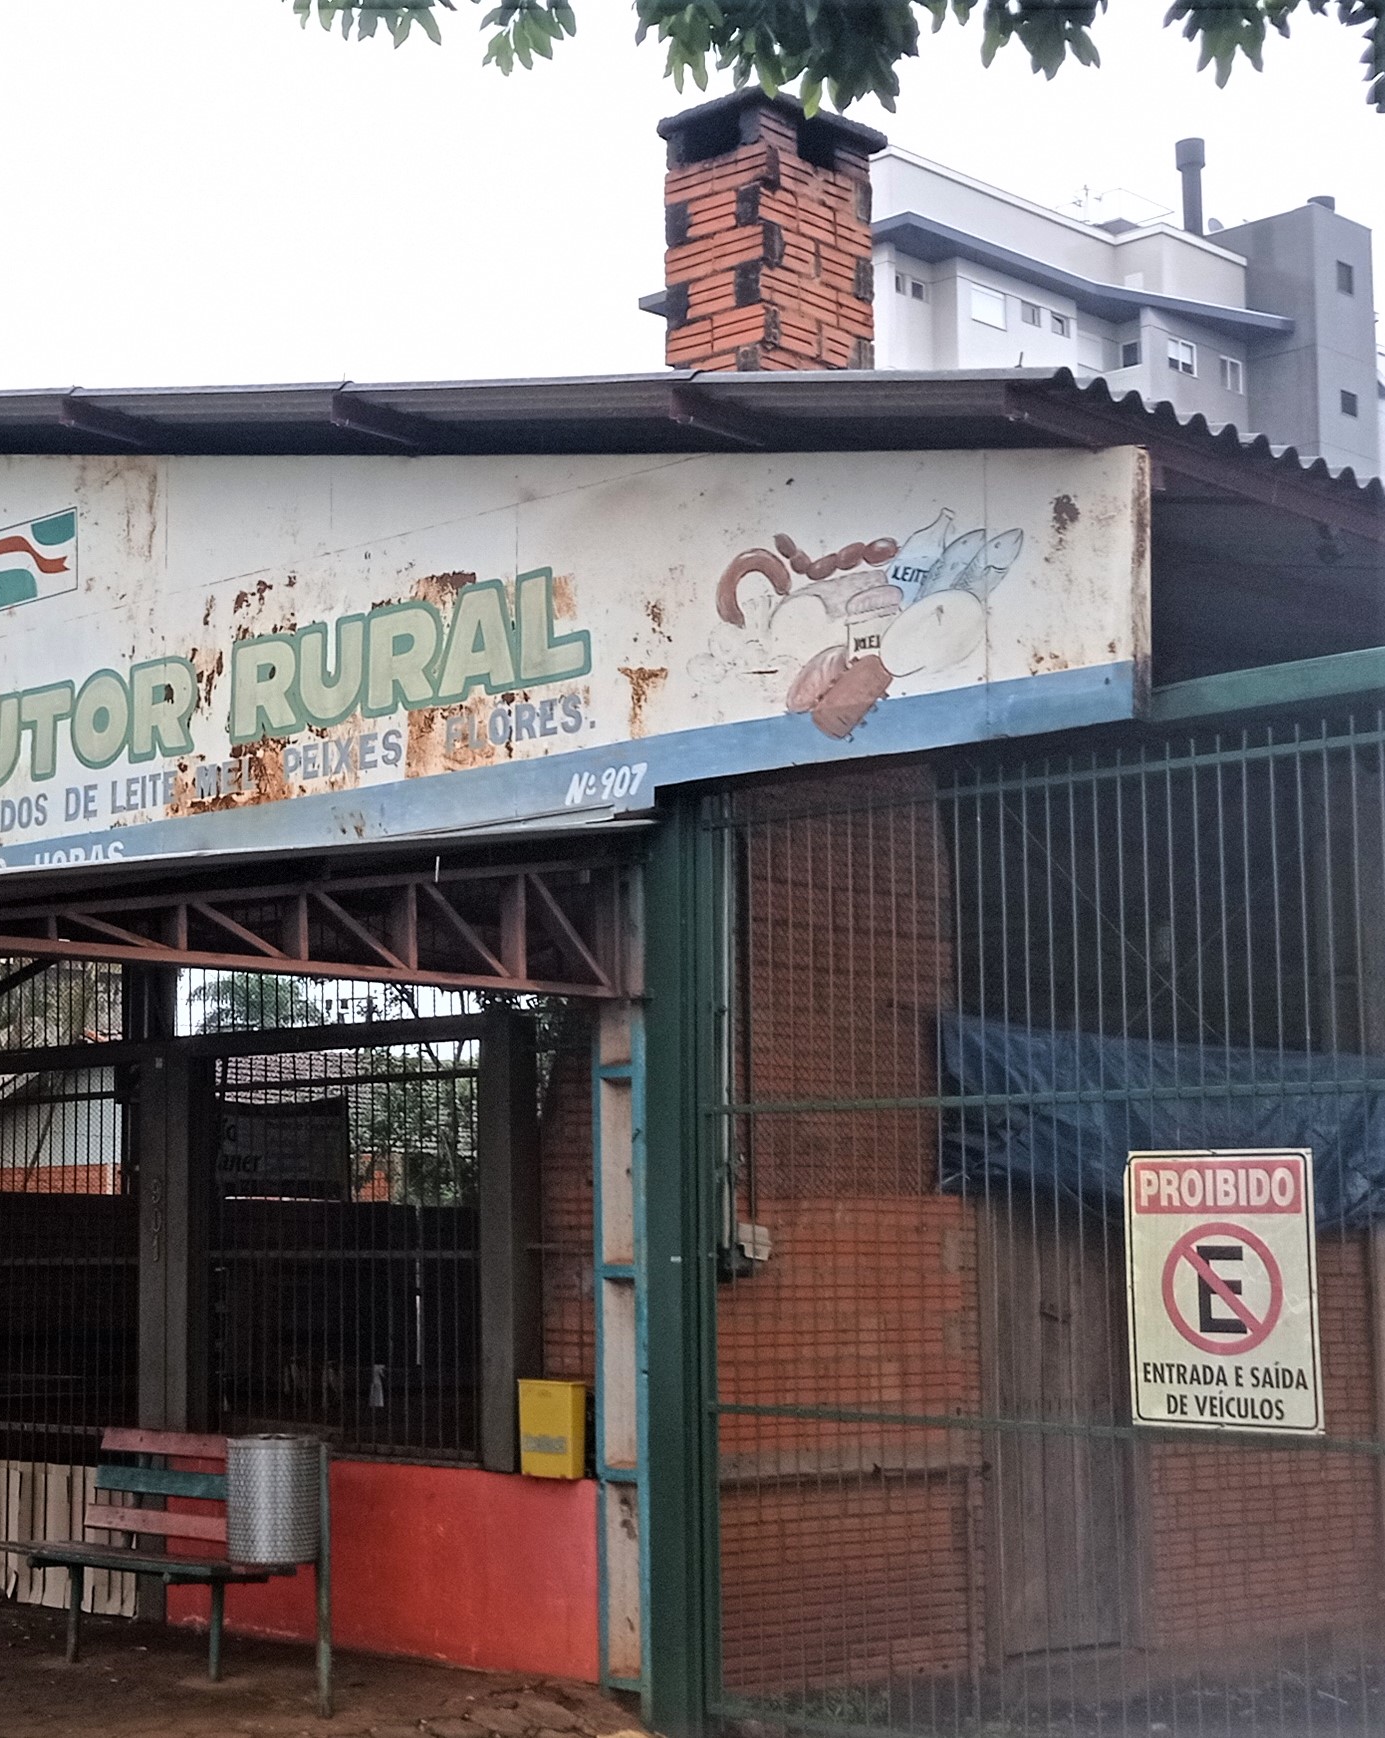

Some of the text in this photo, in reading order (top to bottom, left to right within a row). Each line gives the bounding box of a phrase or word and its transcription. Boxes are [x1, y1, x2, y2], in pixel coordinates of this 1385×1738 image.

[229, 566, 593, 746] RURAL
[65, 783, 98, 822] DE
[111, 770, 176, 815] LEITE
[196, 754, 258, 801] MEL
[283, 729, 403, 783] PEIXES
[601, 762, 648, 800] 907
[1139, 1167, 1295, 1207] PROIBIDO
[1143, 1361, 1309, 1390] ENTRADA E SAÍDA
[1166, 1390, 1285, 1420] DE VEÍCULOS
